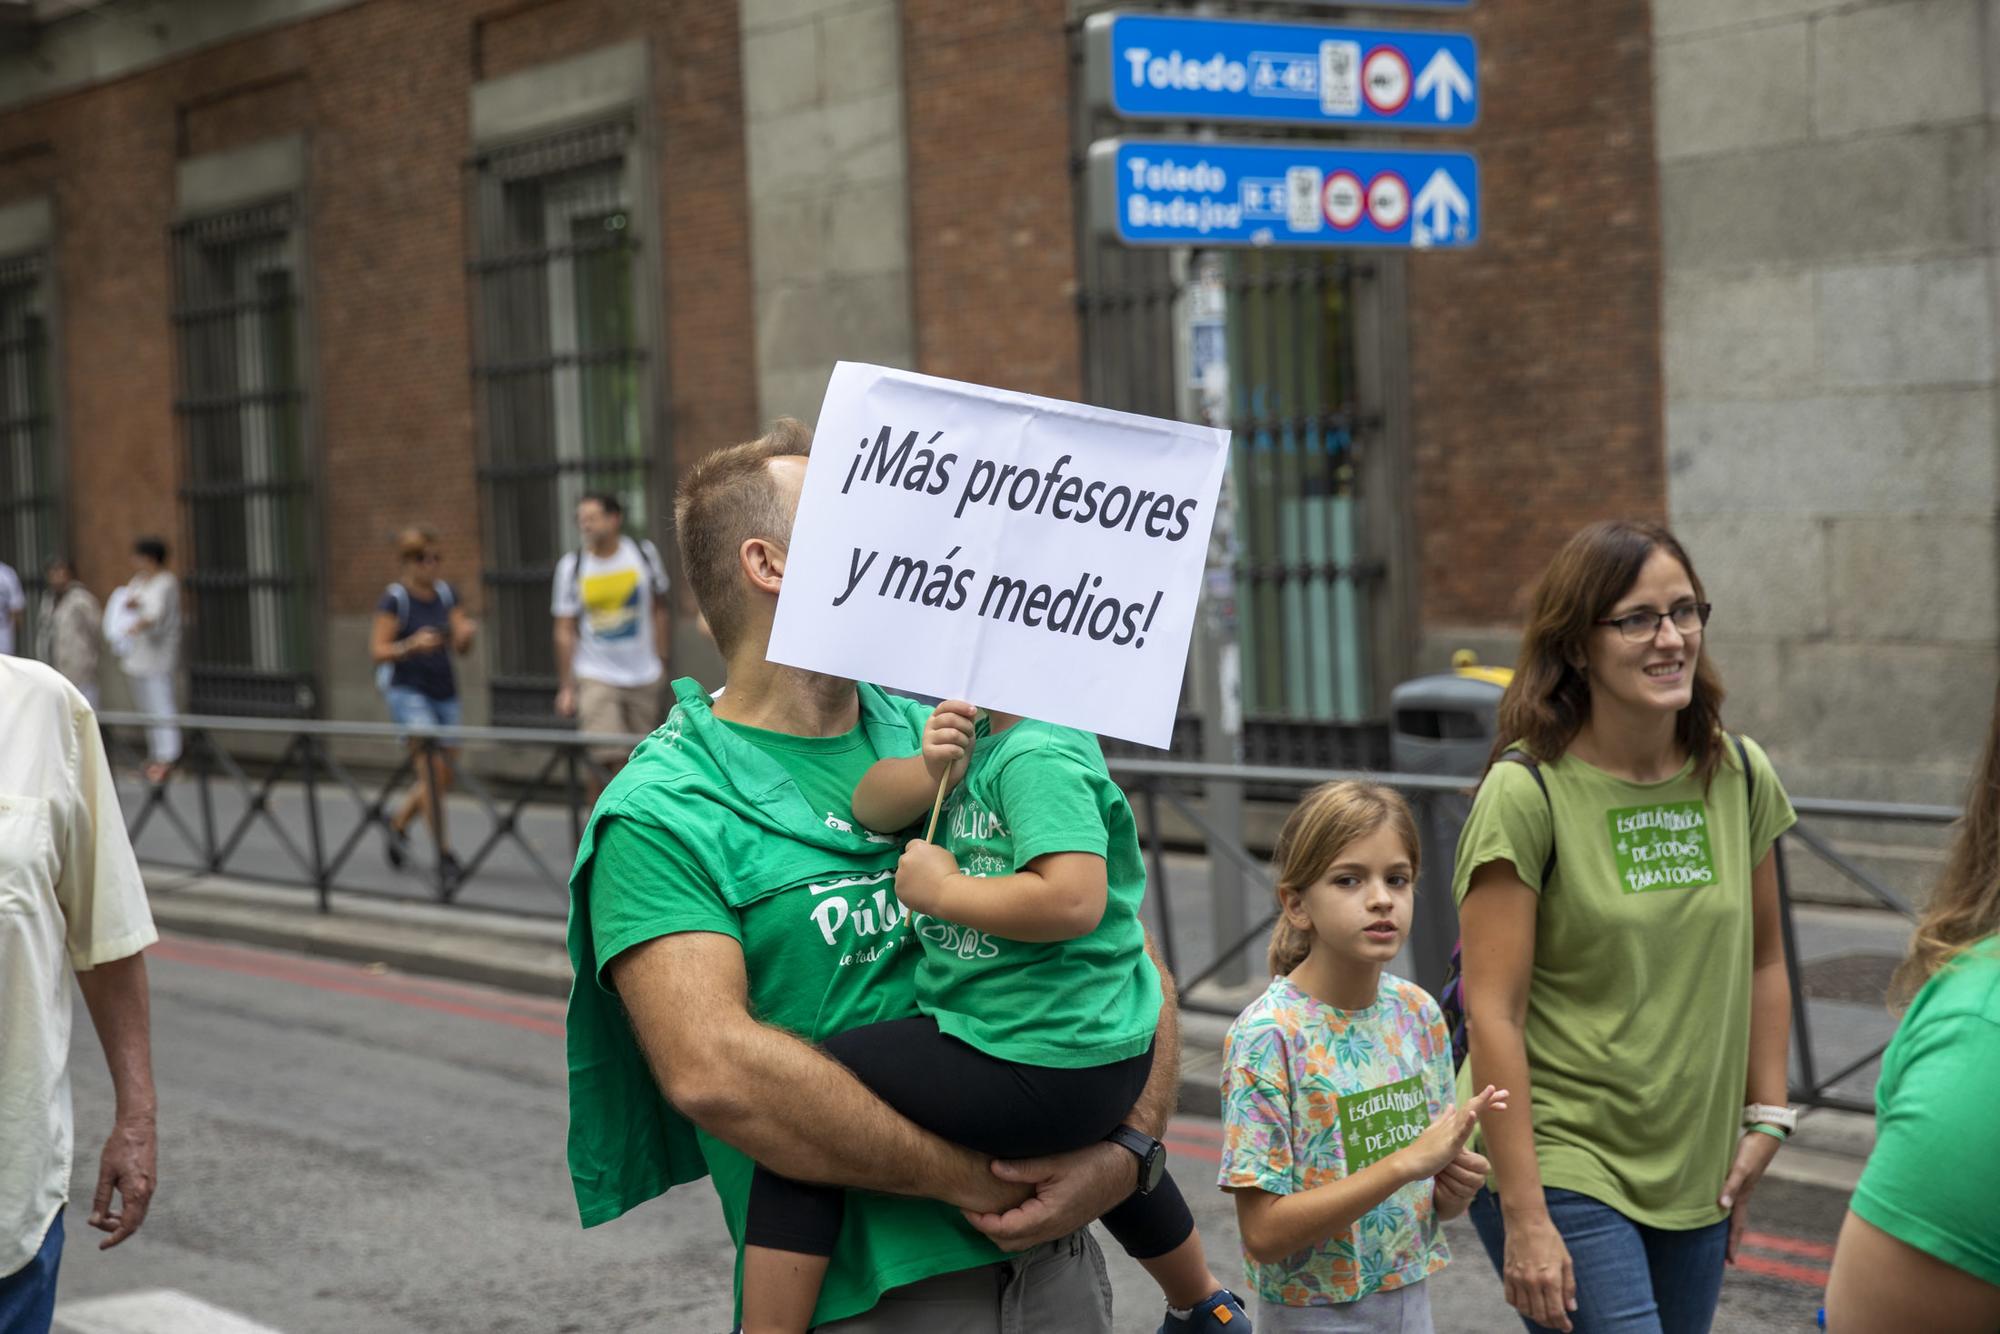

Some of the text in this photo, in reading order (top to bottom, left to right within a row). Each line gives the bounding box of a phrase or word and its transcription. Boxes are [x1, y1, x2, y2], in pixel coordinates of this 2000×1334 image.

[1124, 48, 1247, 93] Toledo
[1127, 157, 1226, 193] Toledo
[1128, 194, 1242, 233] Badajoz
[842, 425, 1198, 542] ¡Más profesores
[832, 545, 1164, 650] y más medios!
[1632, 845, 1656, 863] DE
[1348, 1092, 1396, 1122] ESCUELA
[1365, 1133, 1387, 1152] DE
